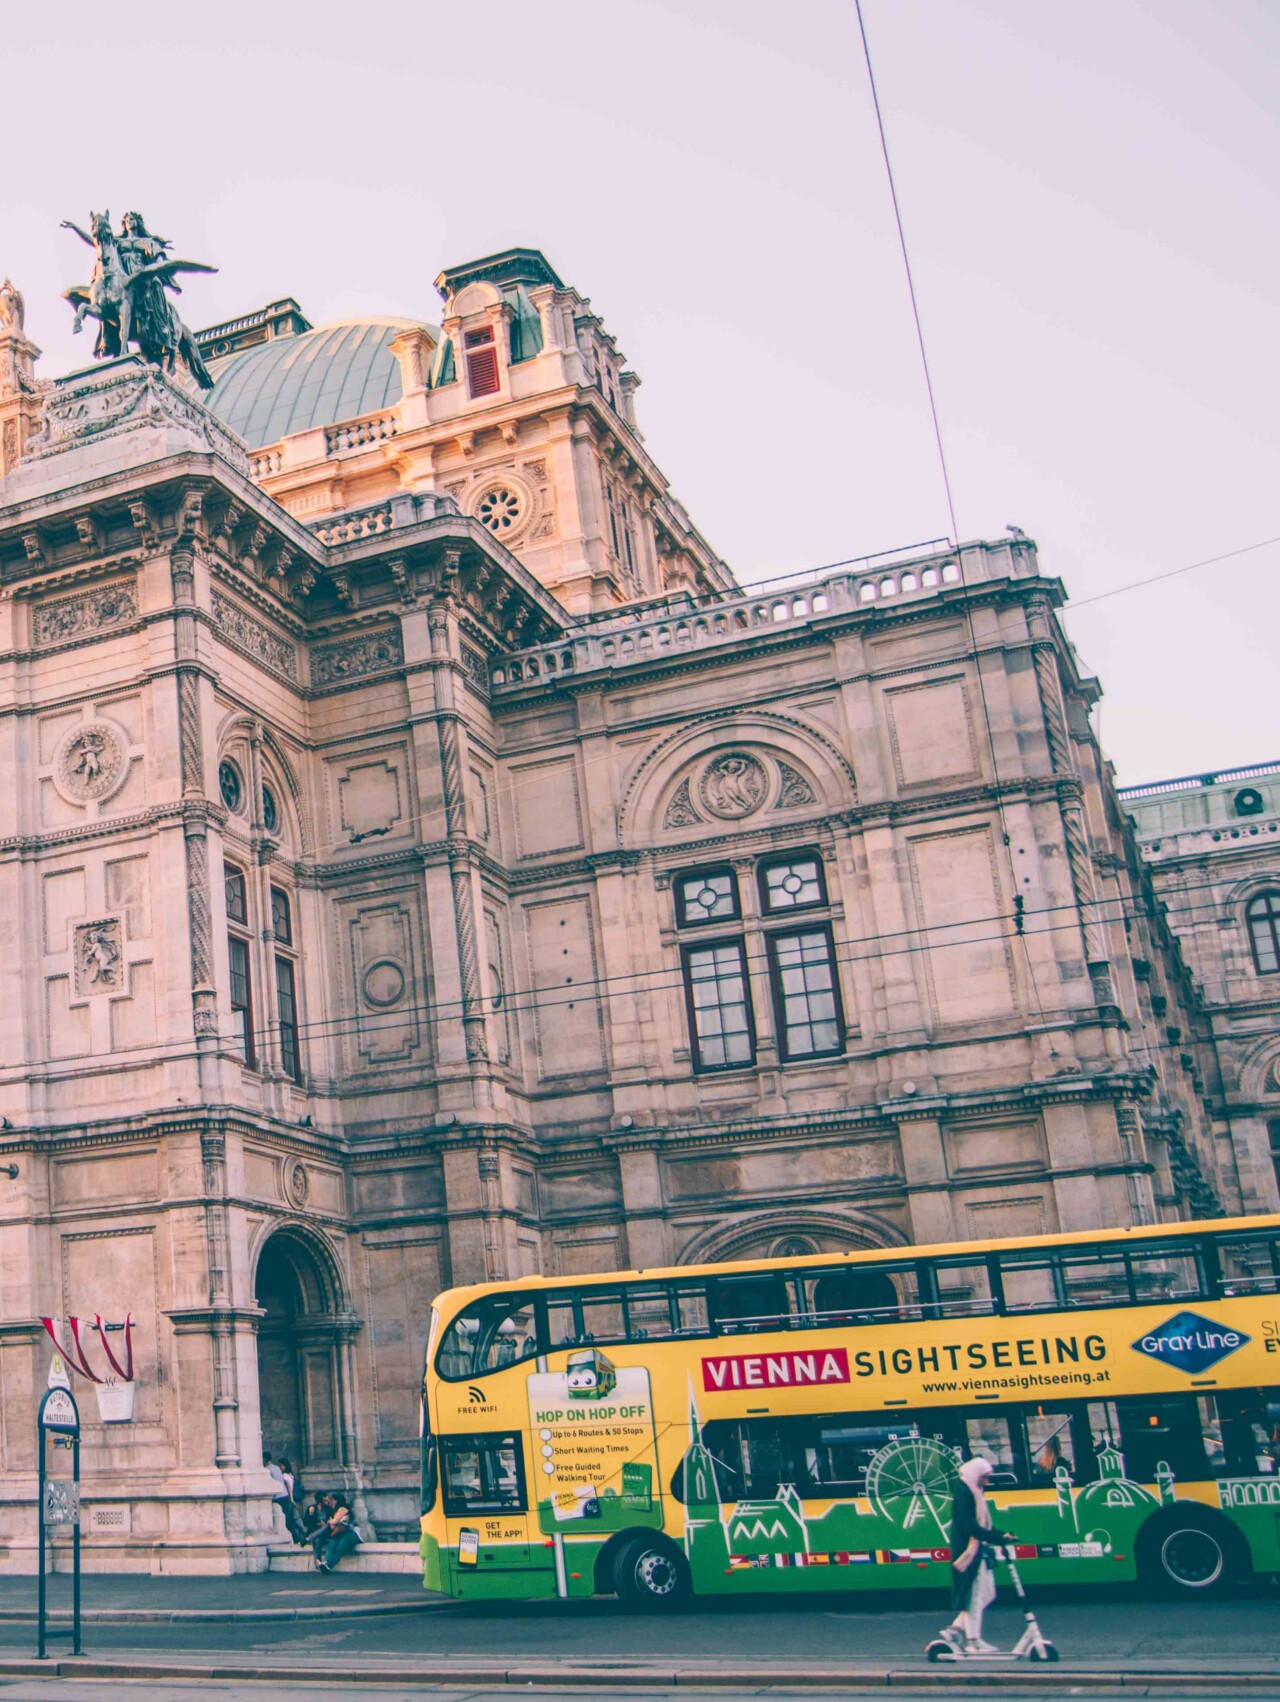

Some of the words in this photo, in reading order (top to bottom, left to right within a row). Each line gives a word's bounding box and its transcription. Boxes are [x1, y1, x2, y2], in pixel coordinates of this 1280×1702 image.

[1141, 1334, 1194, 1353] Gray
[1195, 1331, 1240, 1350] Line
[706, 1352, 845, 1388] VIENNA
[854, 1334, 1107, 1378] SIGHTSEEING
[922, 1369, 1111, 1393] www.viennasightseeing.at
[49, 1392, 71, 1407] AUTOBUS
[46, 1413, 74, 1423] HALTESTELLE
[536, 1410, 563, 1423] HOP
[567, 1409, 585, 1421] ON
[589, 1407, 616, 1420] HOP
[620, 1405, 645, 1418] OFF
[578, 1429, 603, 1437] Routes
[623, 1427, 643, 1435] Stops
[576, 1446, 604, 1454] Waiting
[575, 1463, 601, 1471] Guided
[557, 1474, 587, 1482] Walking
[588, 1473, 605, 1481] Tour
[485, 1521, 501, 1529] GET
[487, 1531, 502, 1539] THE
[504, 1530, 523, 1538] APP!
